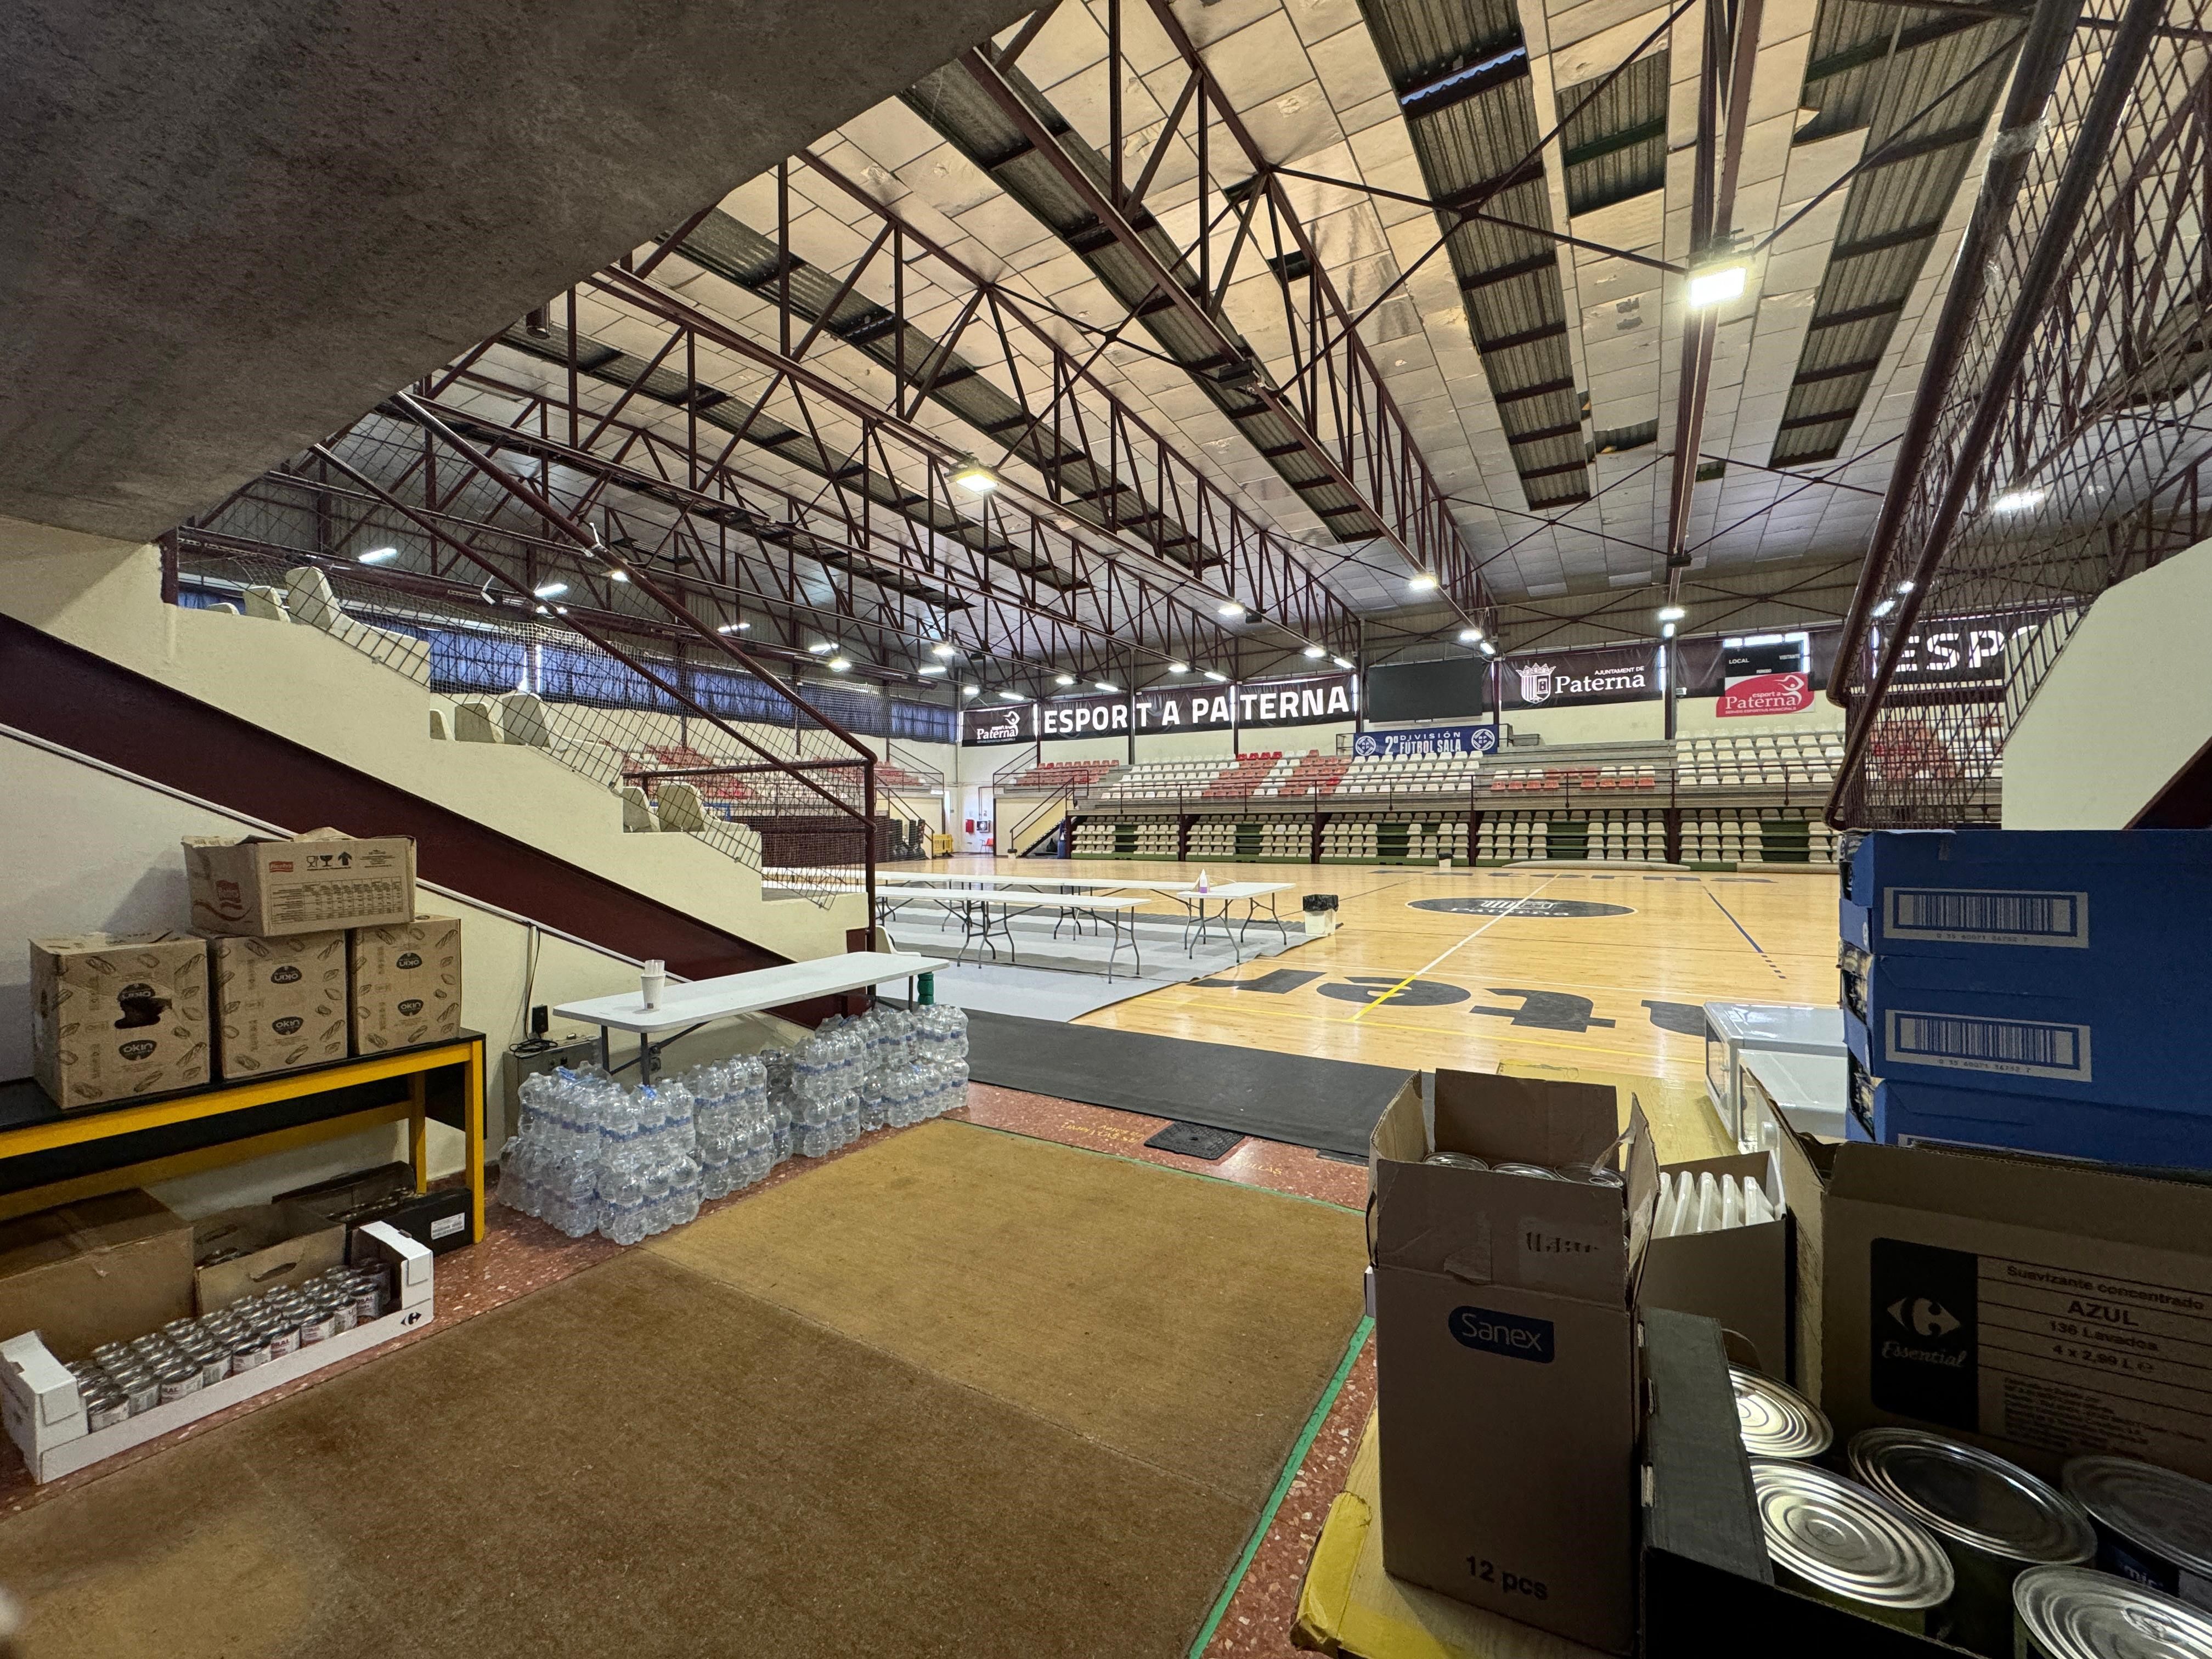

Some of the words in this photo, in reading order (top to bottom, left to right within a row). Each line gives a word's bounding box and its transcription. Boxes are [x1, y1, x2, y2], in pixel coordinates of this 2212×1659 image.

[1895, 624, 2039, 672] ESP
[1594, 667, 1635, 675] AJUNTAMENT
[1555, 674, 1646, 693] Paterna
[1045, 703, 1152, 733] ESPORT
[1161, 701, 1180, 726] A
[1192, 686, 1349, 724] PATERNA
[1725, 696, 1797, 709] Paterna
[977, 728, 1015, 740] Paterna
[1400, 731, 1461, 741] DIVISIÓN
[1400, 737, 1435, 754] FÚTBOL
[1437, 739, 1462, 753] SALA
[2007, 1266, 2094, 1290] Suavizante
[2097, 1283, 2204, 1310] concentrado
[2067, 1301, 2140, 1326] AZUL
[1462, 1313, 1543, 1352] Sanex
[2083, 1327, 2159, 1351] Lavados
[1882, 1340, 1968, 1369] Essential
[2053, 1345, 2063, 1355] 4
[2068, 1348, 2076, 1358] x
[1466, 1556, 1495, 1583] 12
[1502, 1571, 1548, 1600] pcs
